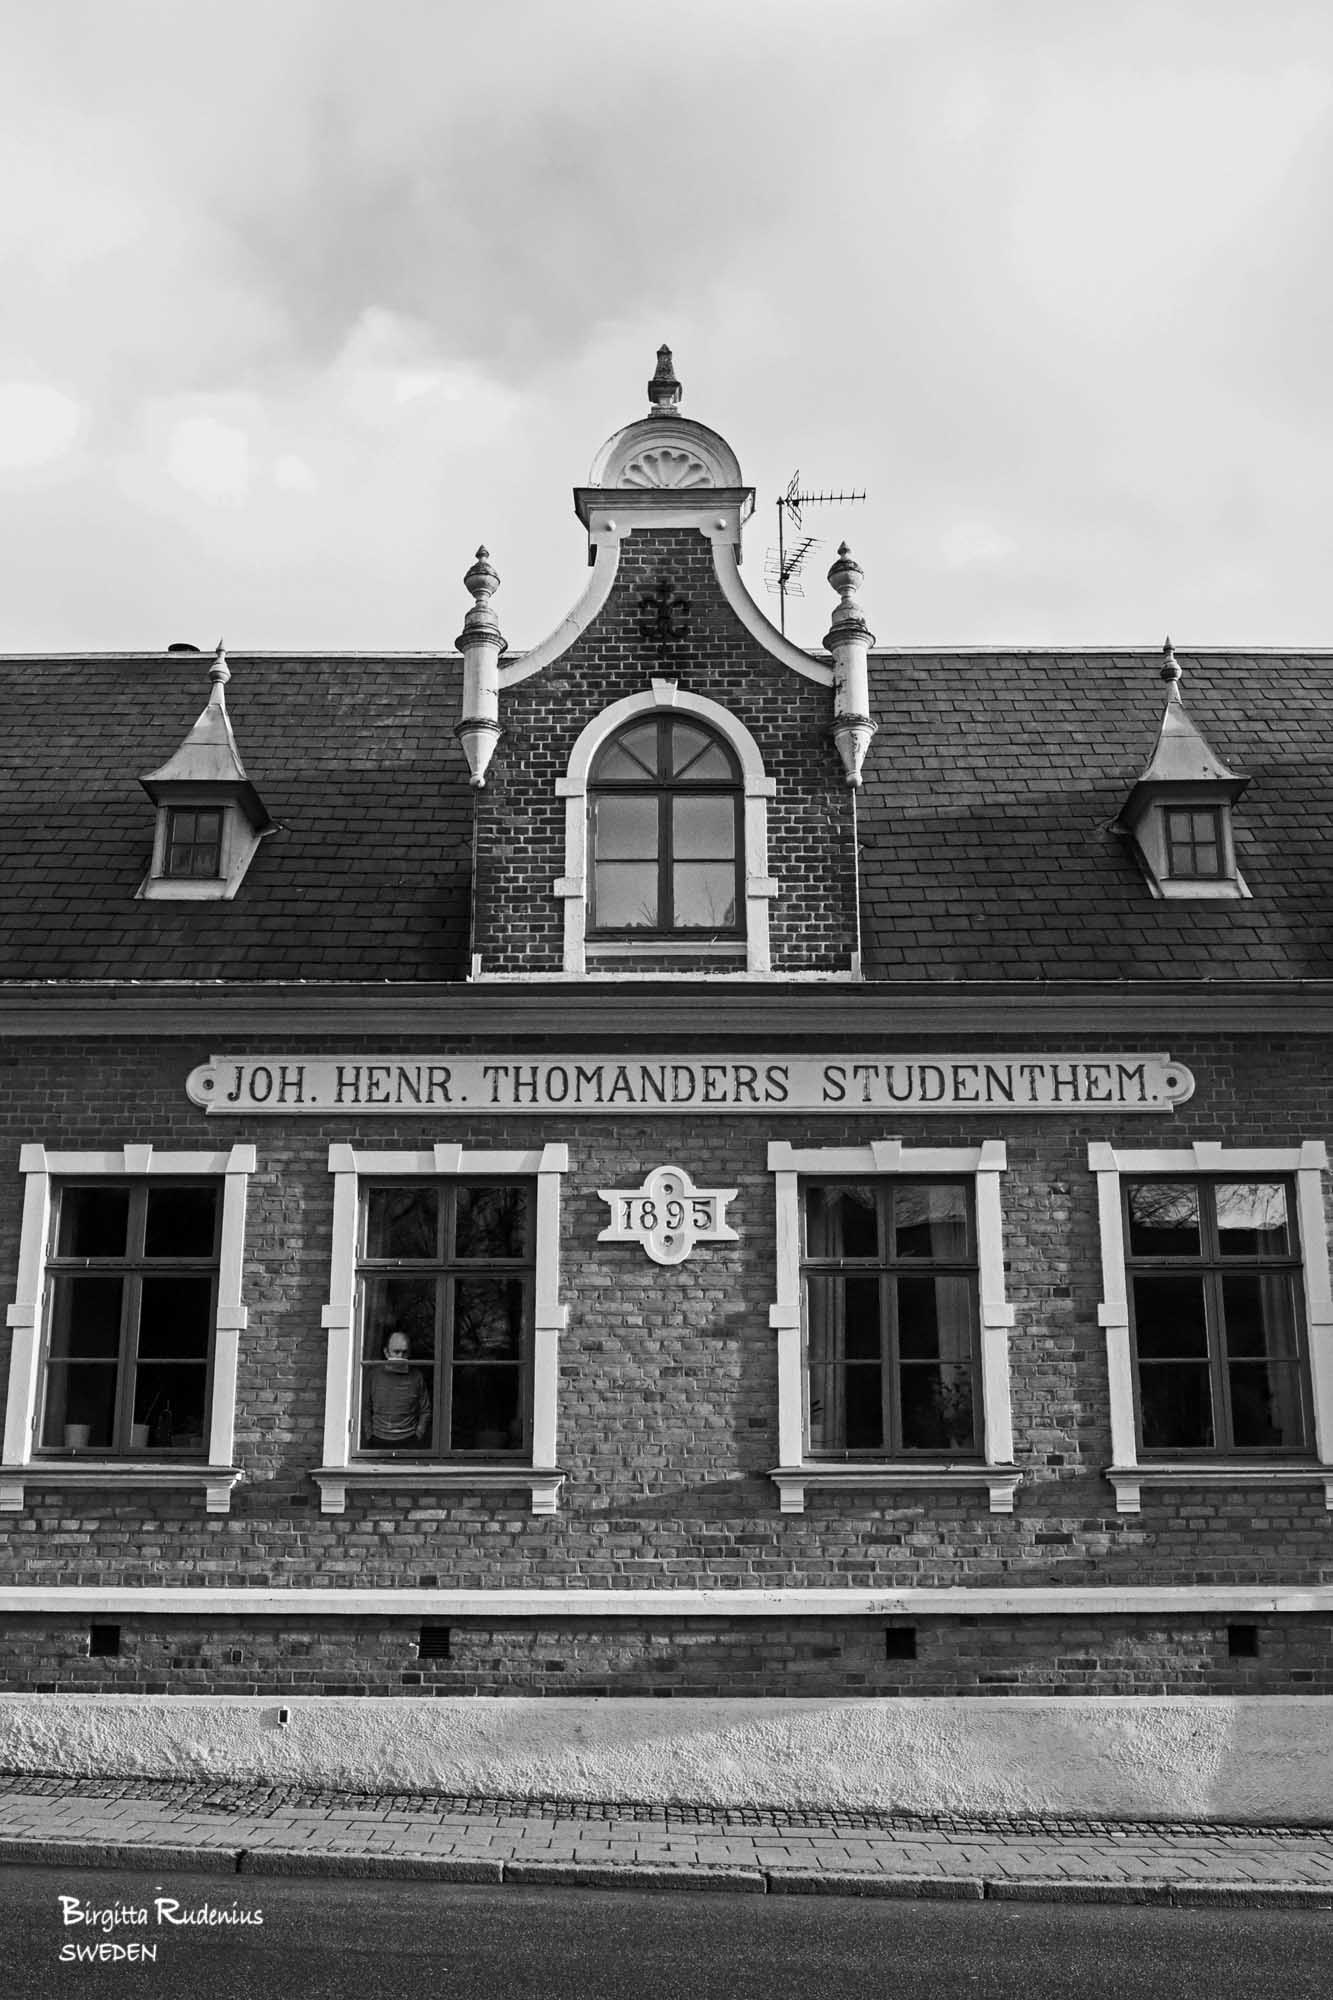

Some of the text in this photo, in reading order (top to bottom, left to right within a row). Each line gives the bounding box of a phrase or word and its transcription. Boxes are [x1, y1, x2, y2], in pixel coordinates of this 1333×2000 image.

[227, 1063, 1159, 1103] JOH. HENR. THOMANDERS STUDENTHEM.
[622, 1200, 712, 1230] 1895
